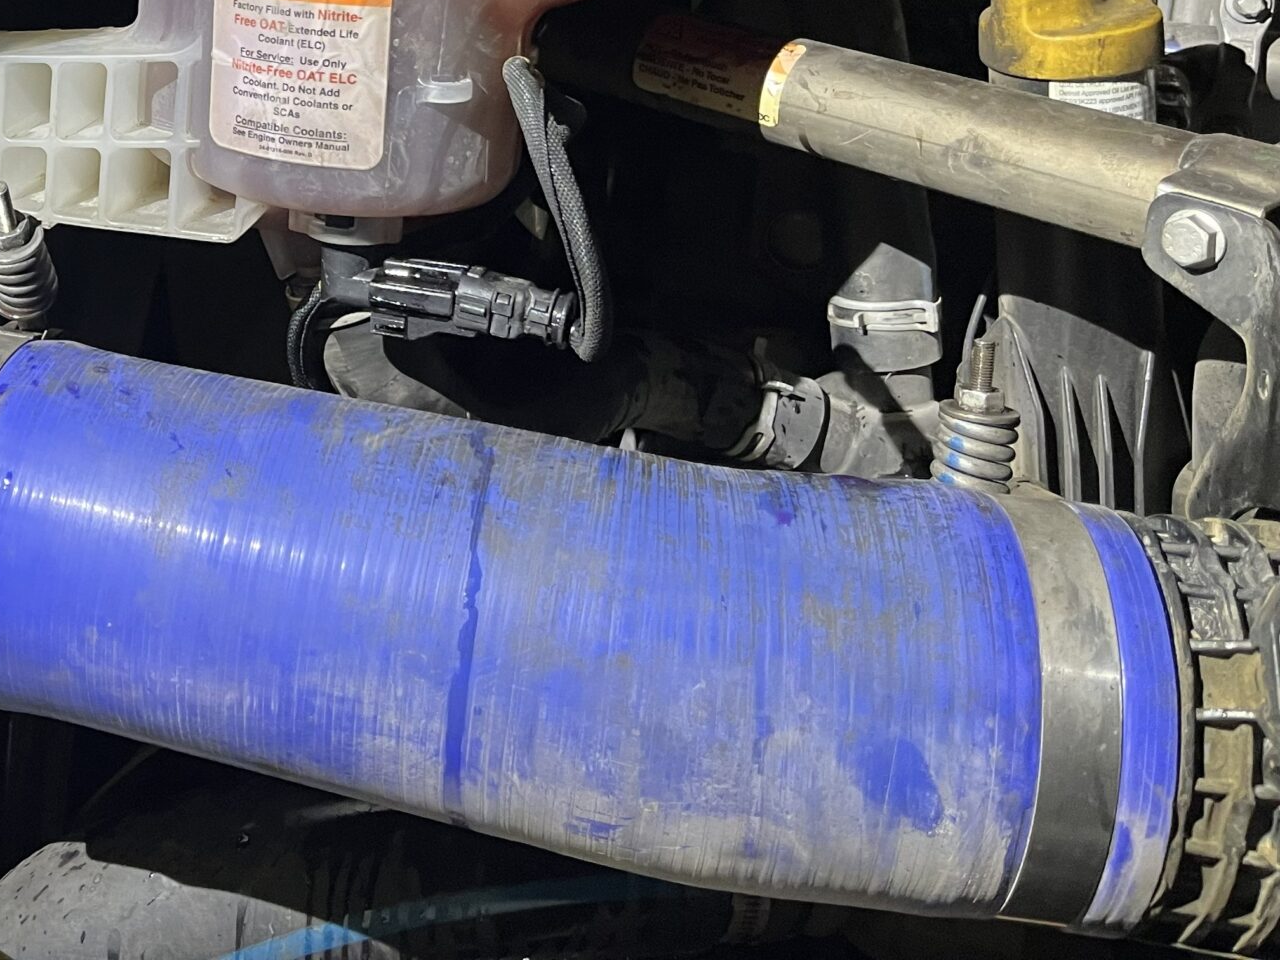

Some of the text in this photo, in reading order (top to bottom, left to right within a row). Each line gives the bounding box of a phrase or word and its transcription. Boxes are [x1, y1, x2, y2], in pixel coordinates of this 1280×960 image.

[233, 0, 362, 22] Factory Filled with Nitrite-
[234, 14, 359, 39] Free OAT Extended Life
[258, 34, 325, 52] Coolant (ELC)
[240, 47, 347, 70] For Service: Use Only
[232, 58, 357, 85] Nitrite-Free OAT ELC
[233, 86, 289, 104] Conventional
[293, 98, 339, 110] Coolants
[243, 76, 340, 97] Coolant. Do Not Add
[273, 107, 300, 118] SCAs
[232, 127, 349, 151] See Engine Owners Manual
[235, 115, 347, 140] Compatible Coolants:
